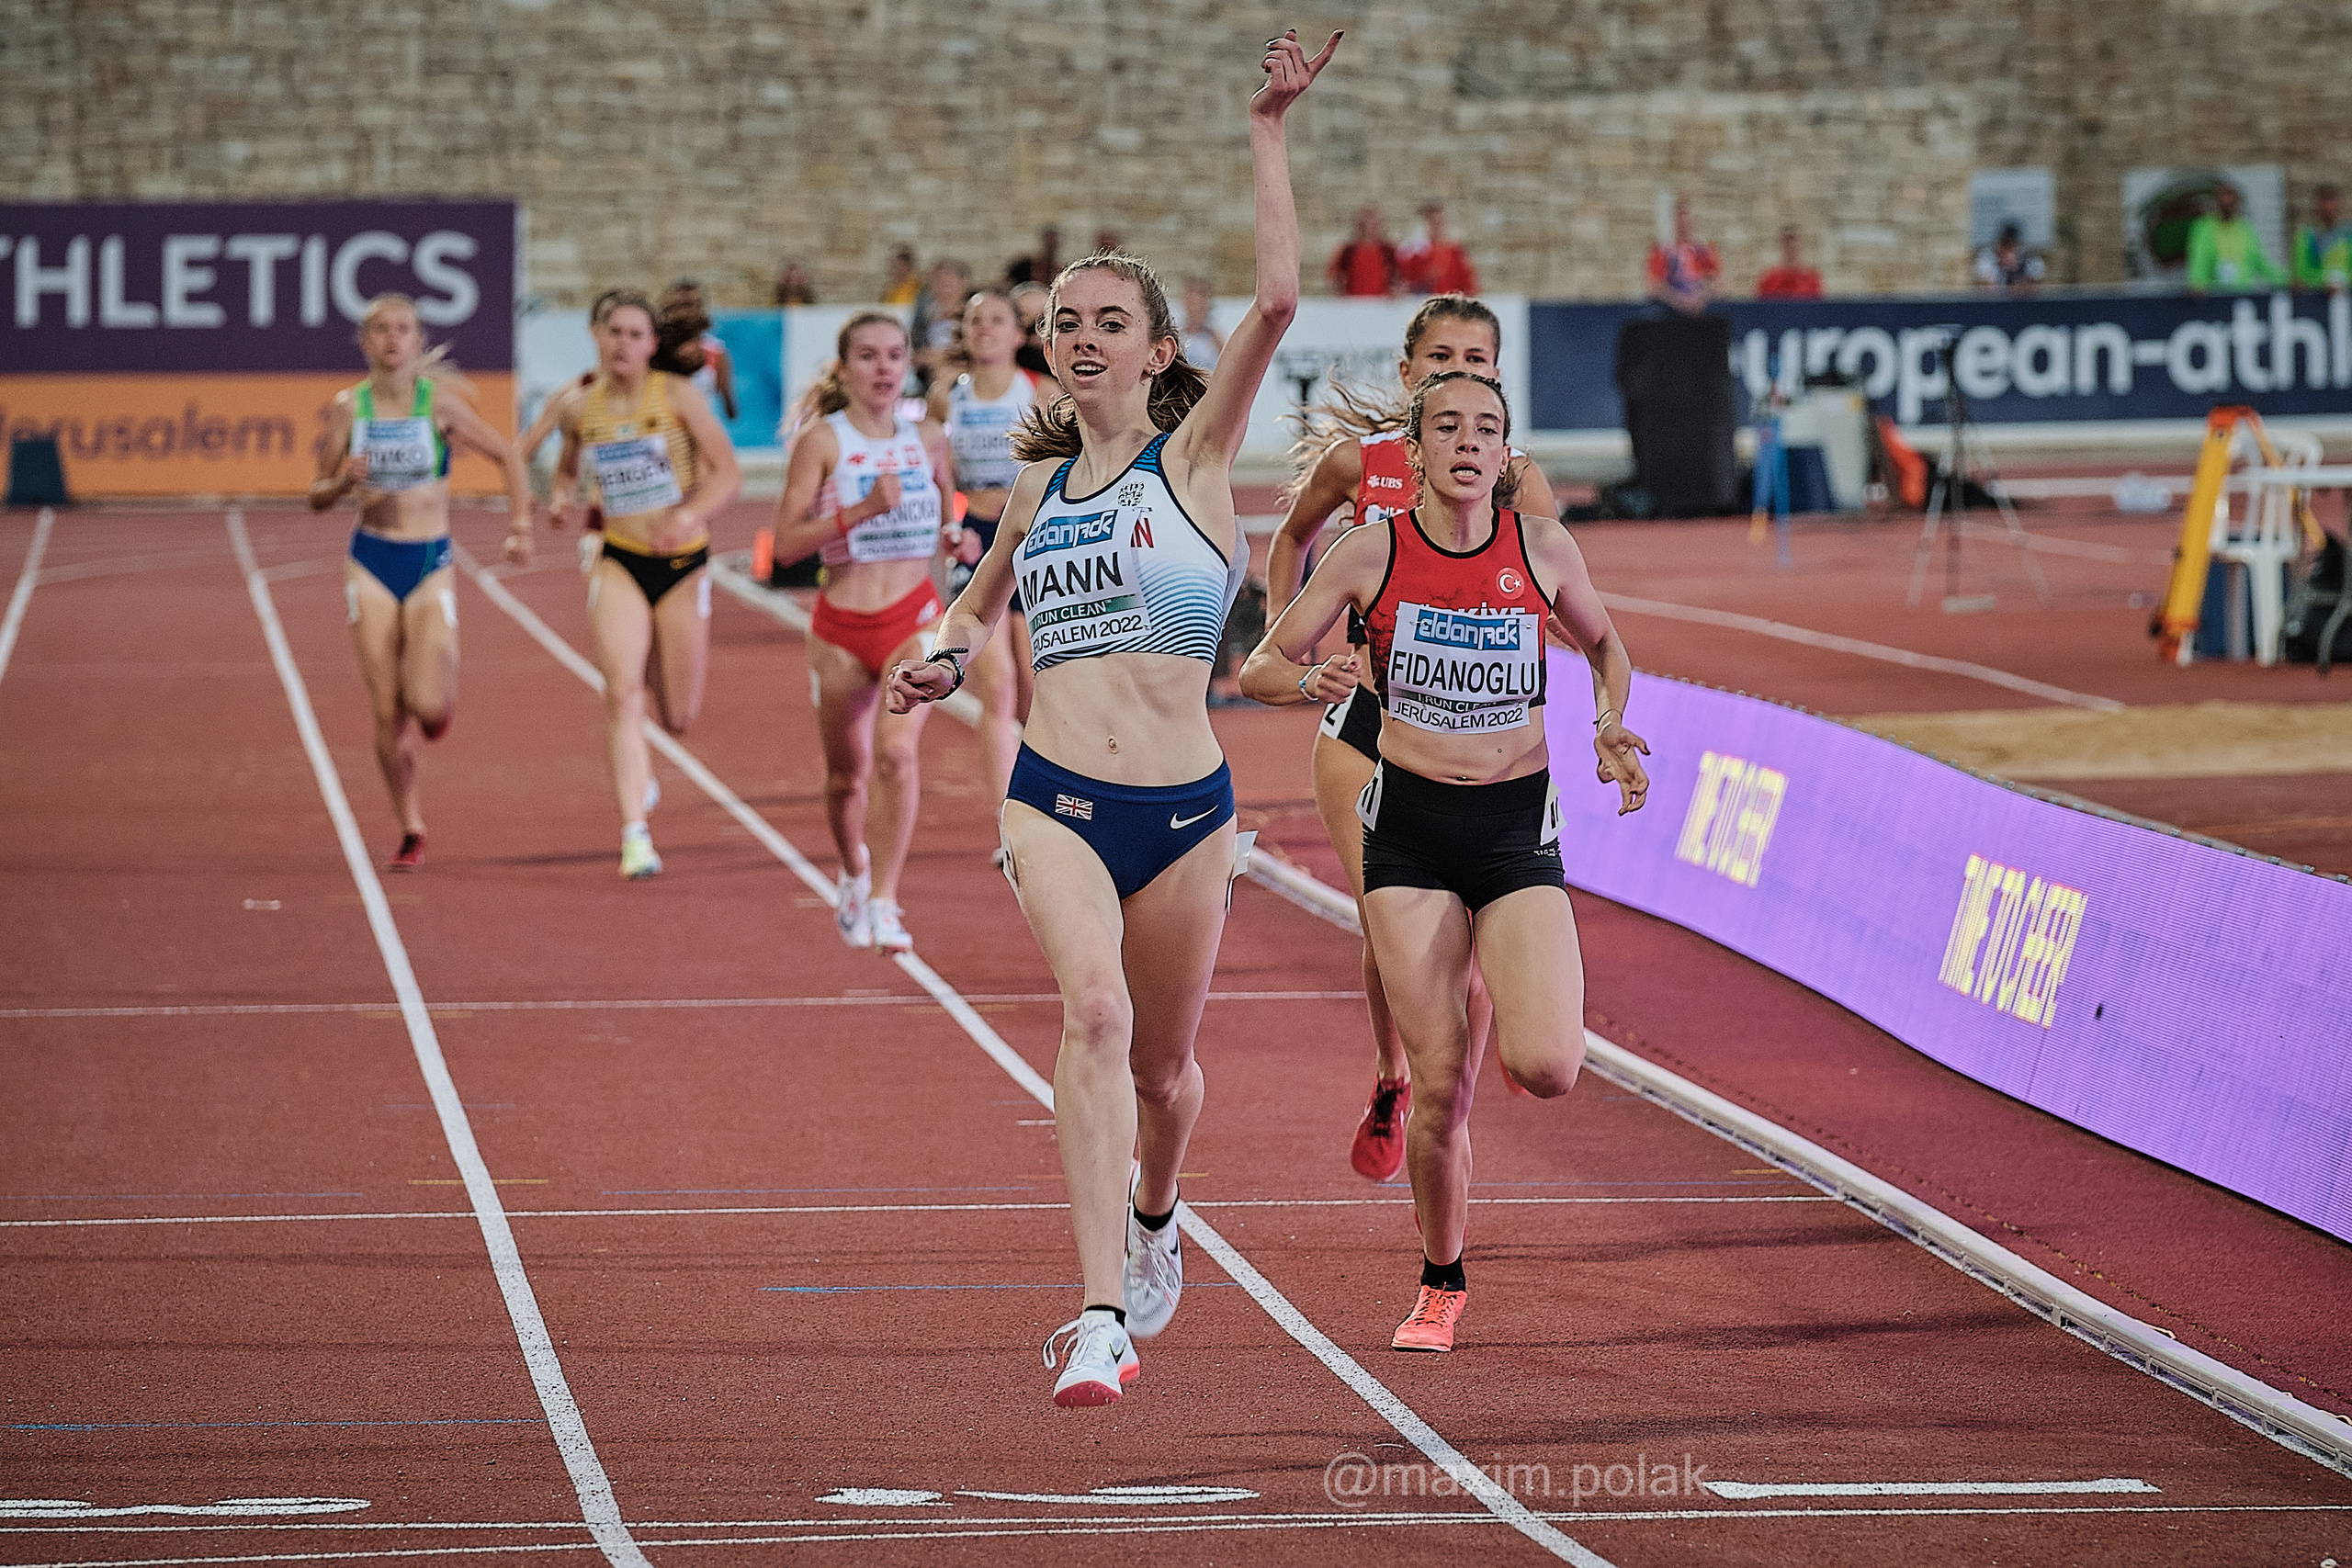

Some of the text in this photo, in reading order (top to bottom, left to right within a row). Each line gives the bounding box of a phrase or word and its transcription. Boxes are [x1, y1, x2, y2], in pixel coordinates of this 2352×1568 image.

[0, 230, 481, 329] HLETICS
[1729, 288, 2352, 425] uropean-athl
[1380, 476, 1403, 490] UBS
[1022, 551, 1124, 612] MANN
[1099, 615, 1144, 637] 2022
[1390, 650, 1535, 695] FIDANOGLU
[1394, 702, 1523, 729] JERUSALEM 2022
[1425, 694, 1453, 711] RUN
